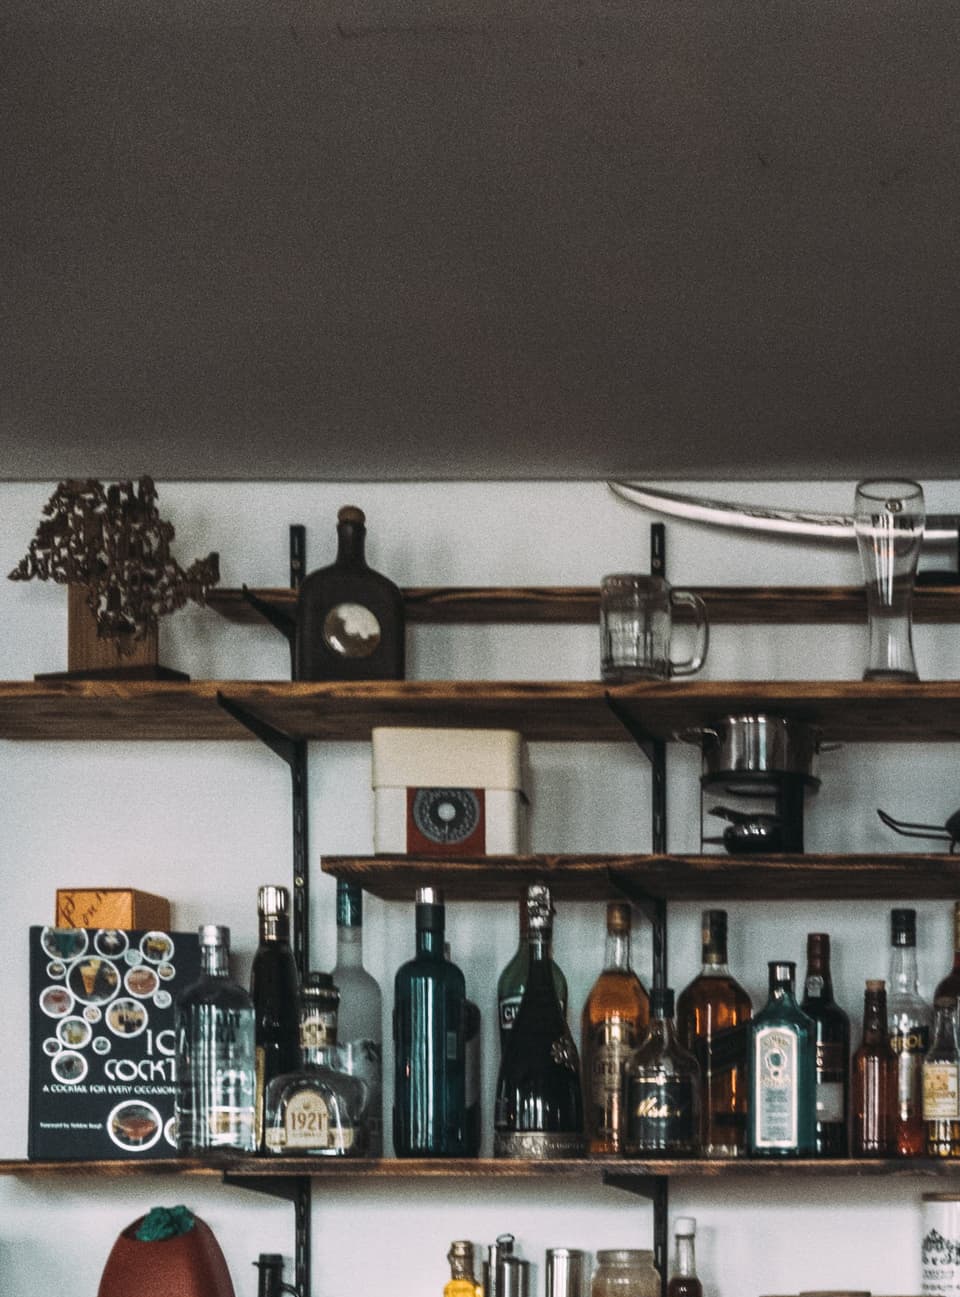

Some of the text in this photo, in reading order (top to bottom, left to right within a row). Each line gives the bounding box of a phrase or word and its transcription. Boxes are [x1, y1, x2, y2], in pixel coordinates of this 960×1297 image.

[104, 1058, 176, 1082] COCKT
[42, 1084, 176, 1096] A COCKTAIL FOR EVERY OCCASION
[290, 1111, 323, 1131] 1921
